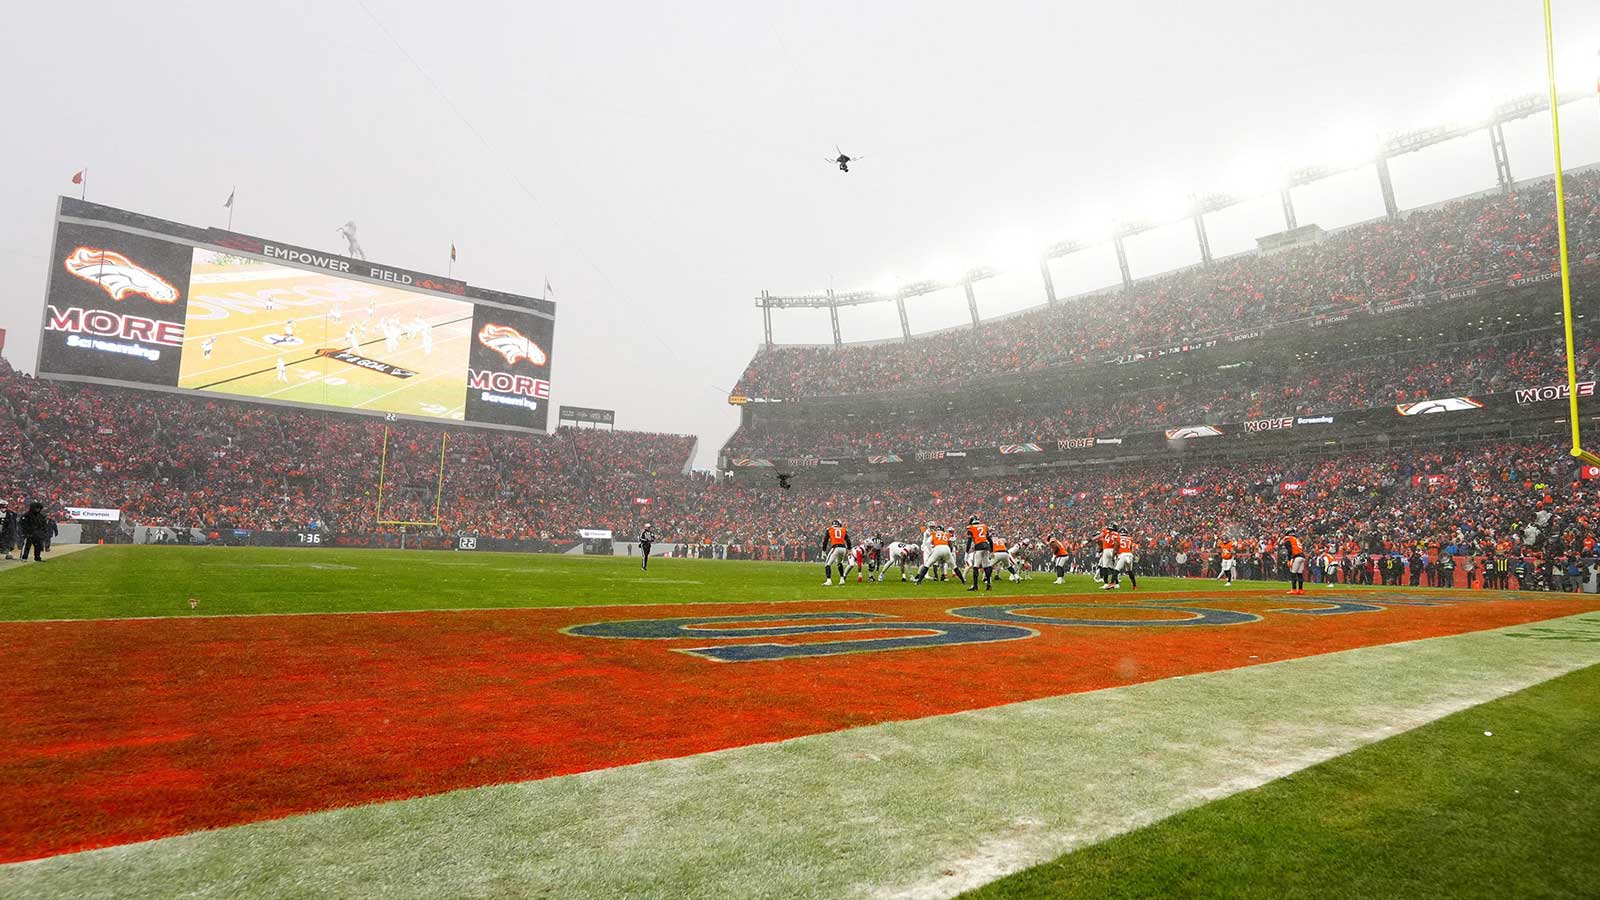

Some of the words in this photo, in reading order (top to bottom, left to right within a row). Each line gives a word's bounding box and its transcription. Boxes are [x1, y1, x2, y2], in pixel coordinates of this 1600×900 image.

[263, 245, 350, 272] EMPOWER
[370, 268, 412, 285] FIELD
[1526, 271, 1561, 284] FLETCHE
[1384, 302, 1415, 313] MANNING
[1324, 315, 1349, 325] THOMAS
[45, 304, 185, 348] MORE
[1234, 331, 1259, 342] BOWLEN
[66, 335, 160, 361] Screaming
[467, 368, 550, 399] MORE
[481, 392, 537, 410] Screaming
[298, 533, 320, 543] 7:36
[834, 528, 842, 539] 0
[977, 527, 985, 538] 2
[460, 538, 475, 549] 22
[1120, 538, 1132, 549] 57
